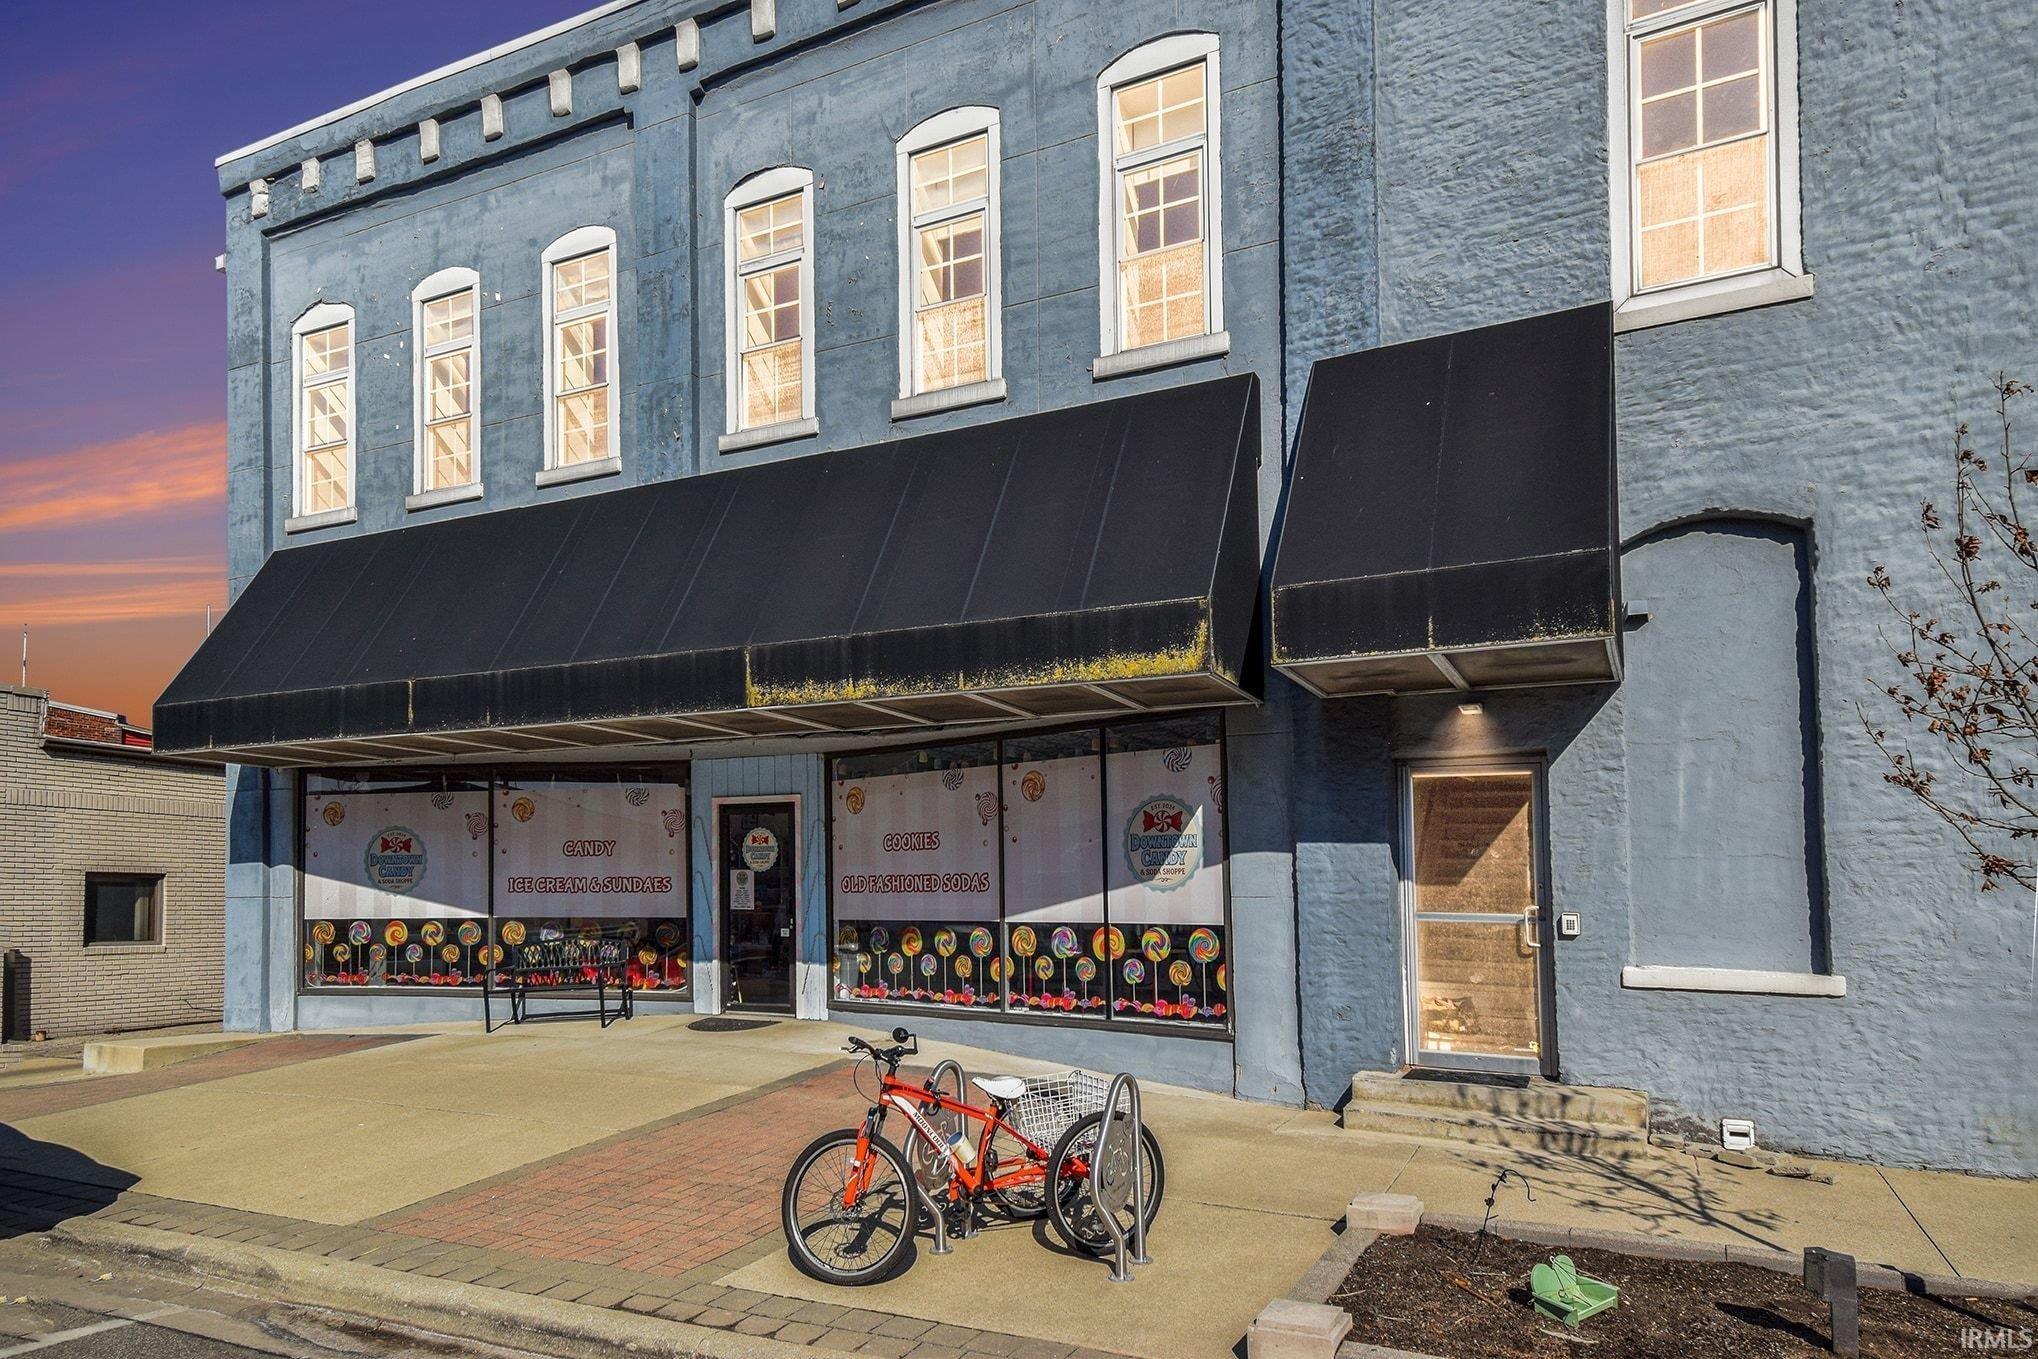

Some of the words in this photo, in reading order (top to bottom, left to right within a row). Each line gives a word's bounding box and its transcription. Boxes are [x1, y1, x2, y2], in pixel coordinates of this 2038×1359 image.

[563, 840, 616, 857] CANDY
[883, 831, 940, 852] COOKIES
[1130, 833, 1198, 851] DOWNTOWN
[370, 853, 423, 867] DOWNTOWN
[1141, 850, 1187, 867] CANDY
[378, 865, 415, 878] CANDY
[1146, 868, 1161, 876] SODA
[1163, 868, 1186, 876] SHOPPE
[508, 877, 534, 893] ICE
[534, 877, 587, 893] CREAM
[589, 877, 602, 893] &
[600, 876, 672, 893] SUNDAES
[841, 875, 867, 893] OLD
[867, 874, 941, 893] FASHIONED
[941, 872, 990, 893] SODAS
